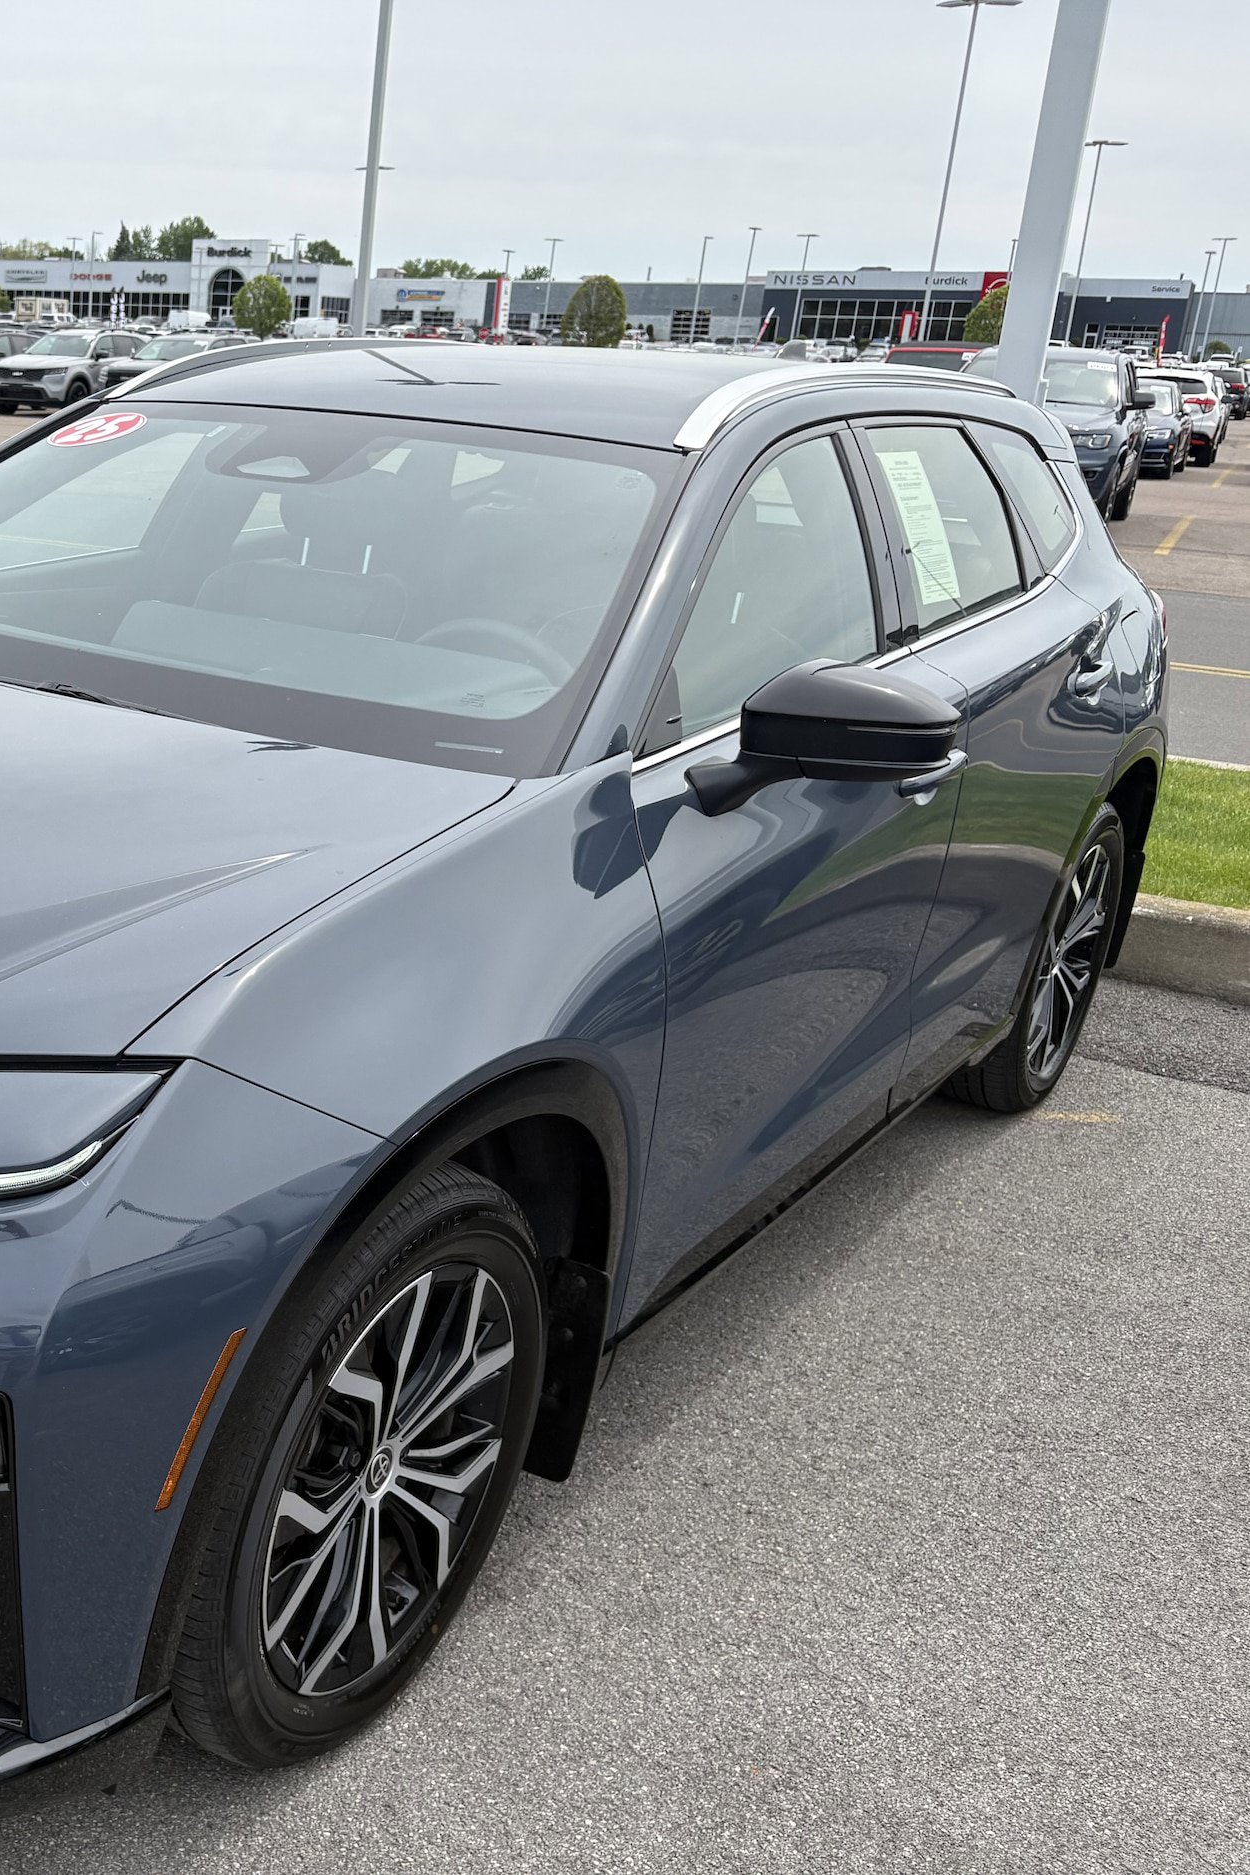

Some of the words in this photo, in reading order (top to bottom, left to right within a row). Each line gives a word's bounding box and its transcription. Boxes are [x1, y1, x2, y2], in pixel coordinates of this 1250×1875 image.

[207, 246, 252, 257] Burdick
[137, 269, 167, 286] Jeep
[774, 274, 856, 286] NISSAN
[1152, 285, 1180, 293] Service
